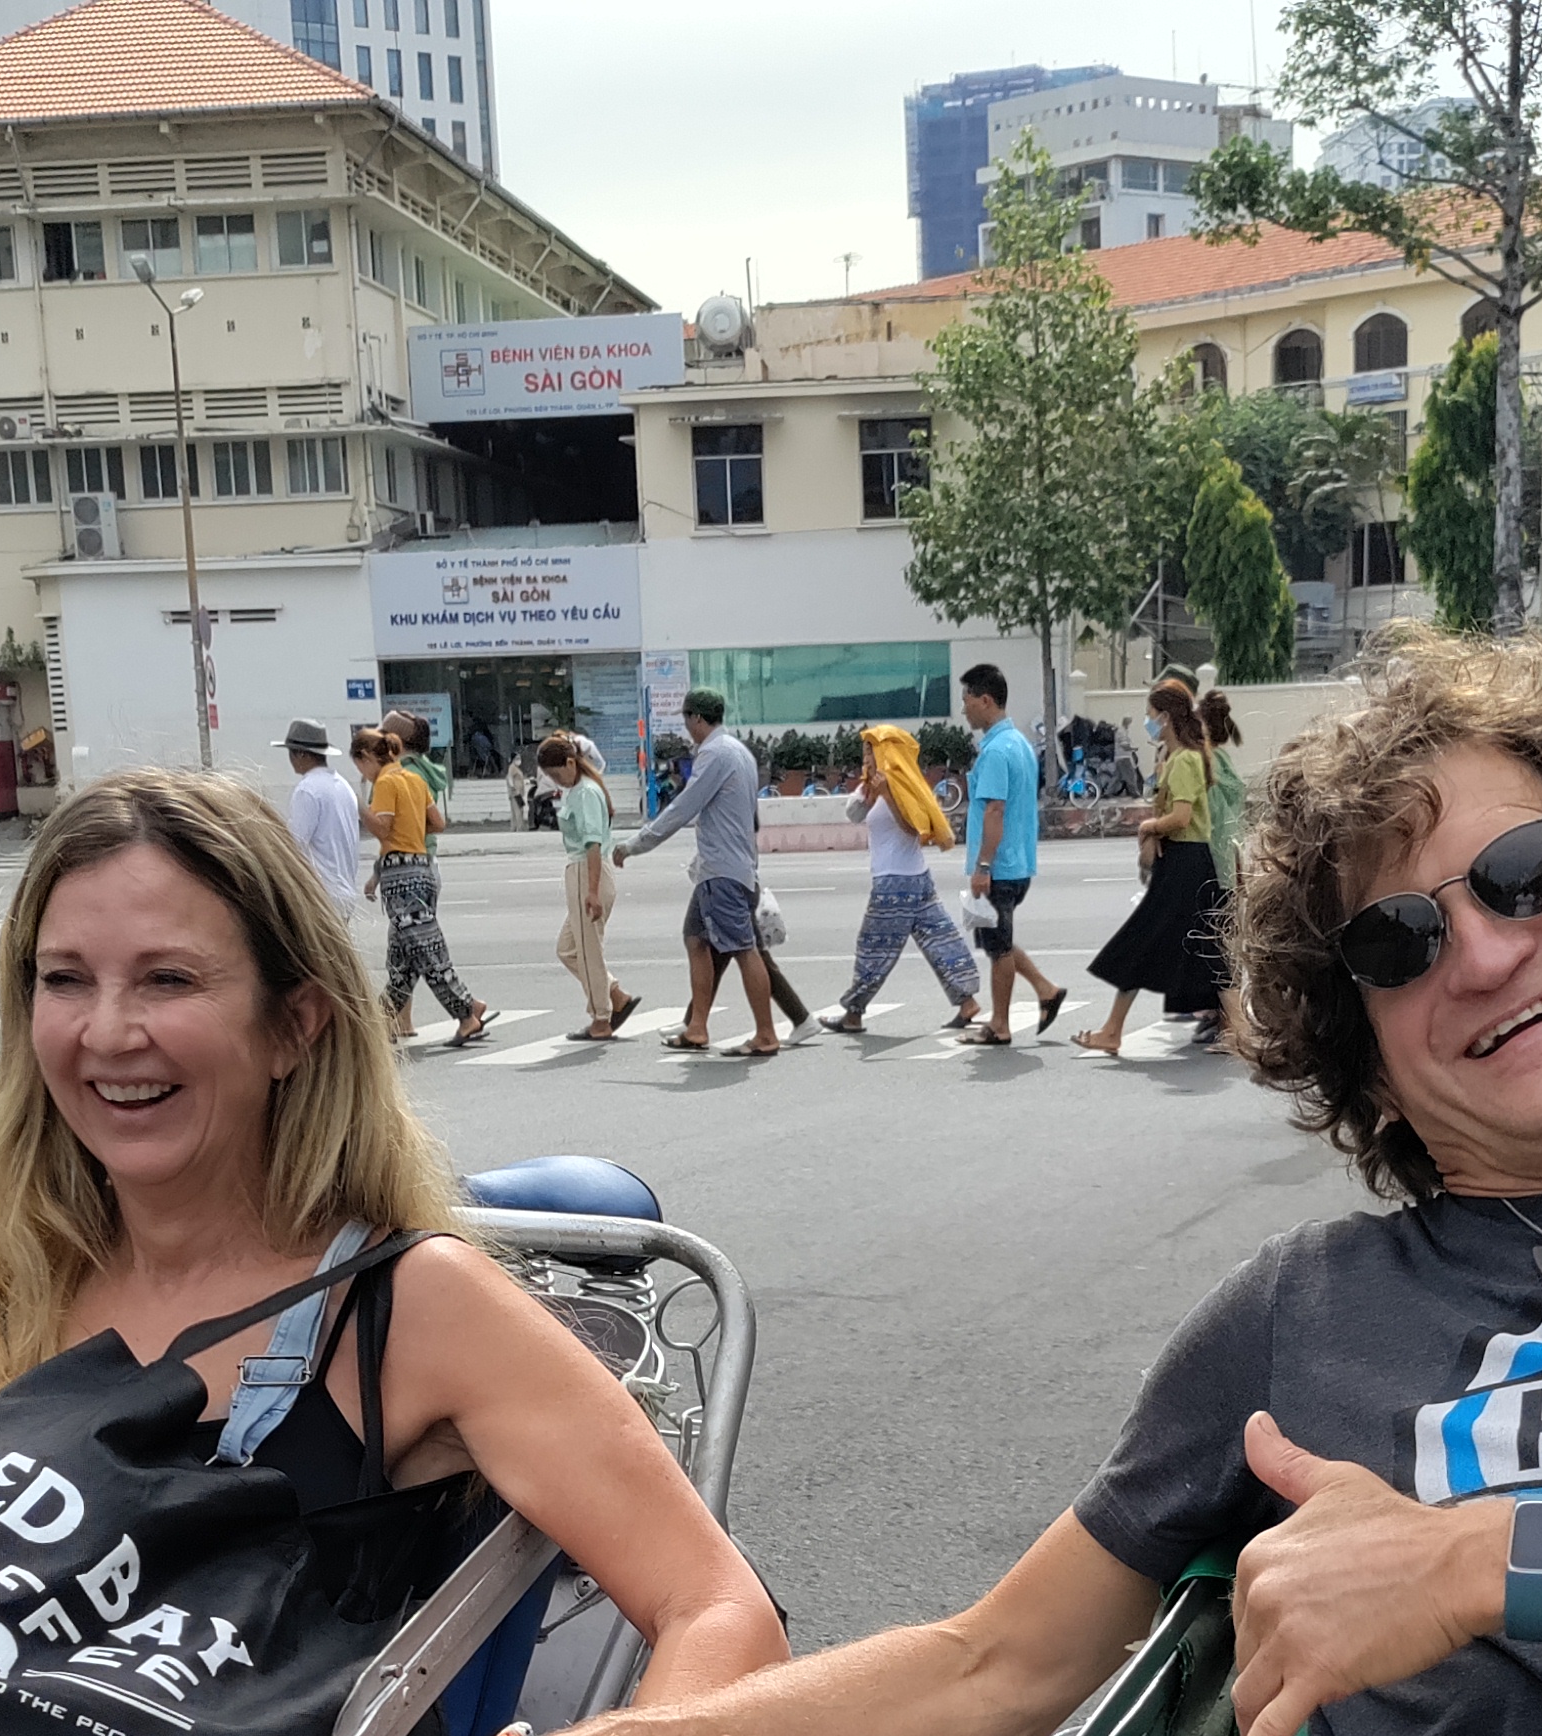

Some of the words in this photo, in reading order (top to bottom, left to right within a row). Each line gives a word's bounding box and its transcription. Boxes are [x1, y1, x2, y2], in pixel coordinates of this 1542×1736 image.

[607, 342, 652, 358] KHOA
[523, 368, 562, 393] SÀI
[570, 366, 623, 391] GÒN
[491, 587, 514, 603] SÀI
[519, 586, 551, 602] GÒN
[389, 612, 417, 626] KHU
[422, 608, 459, 625] KHÁM
[463, 611, 494, 627] DỊCH
[498, 611, 517, 625] VỤ
[521, 608, 556, 622] THEO
[560, 605, 589, 620] YÊU
[592, 602, 621, 619] CẦU
[76, 1533, 255, 1677] BAY
[17, 1687, 67, 1721] THE
